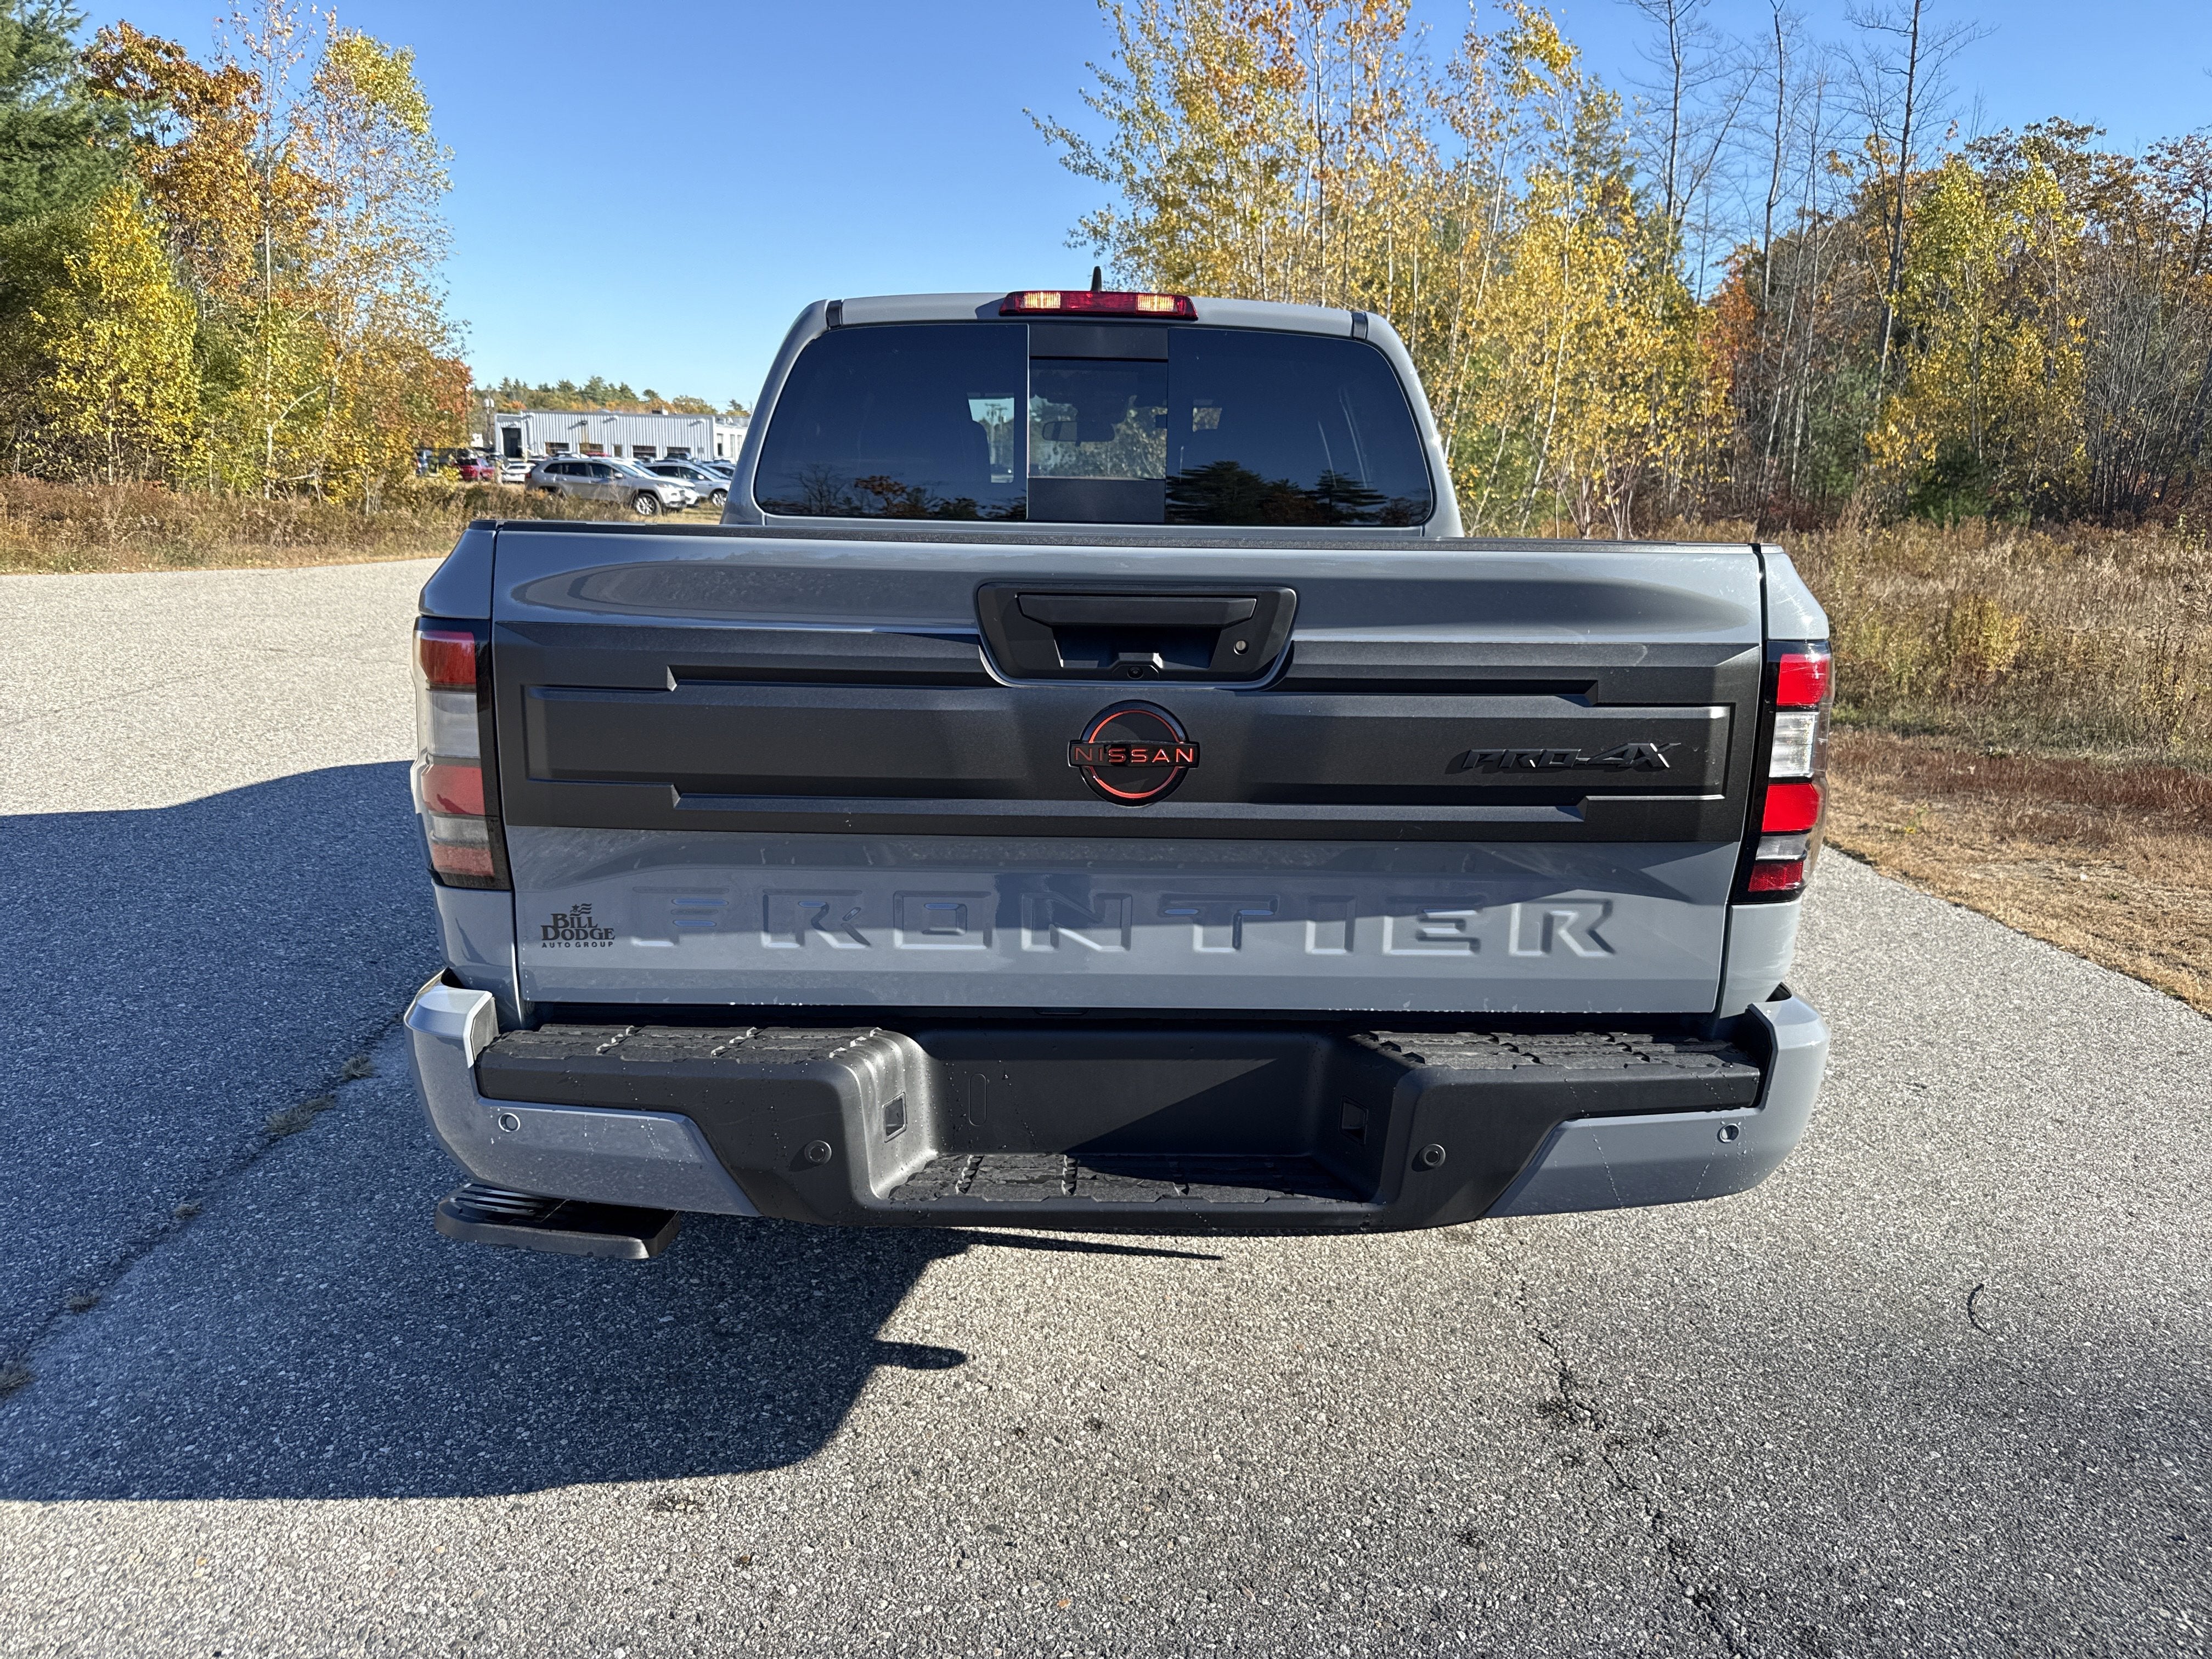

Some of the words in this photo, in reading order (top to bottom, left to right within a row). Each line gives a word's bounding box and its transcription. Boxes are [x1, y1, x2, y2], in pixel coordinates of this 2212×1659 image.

[1074, 747, 1194, 763] NISSAN
[1459, 742, 1683, 769] PRO-4X
[551, 913, 598, 929] BILL
[630, 885, 1616, 958] FRONTIER
[540, 925, 615, 940] DODGE
